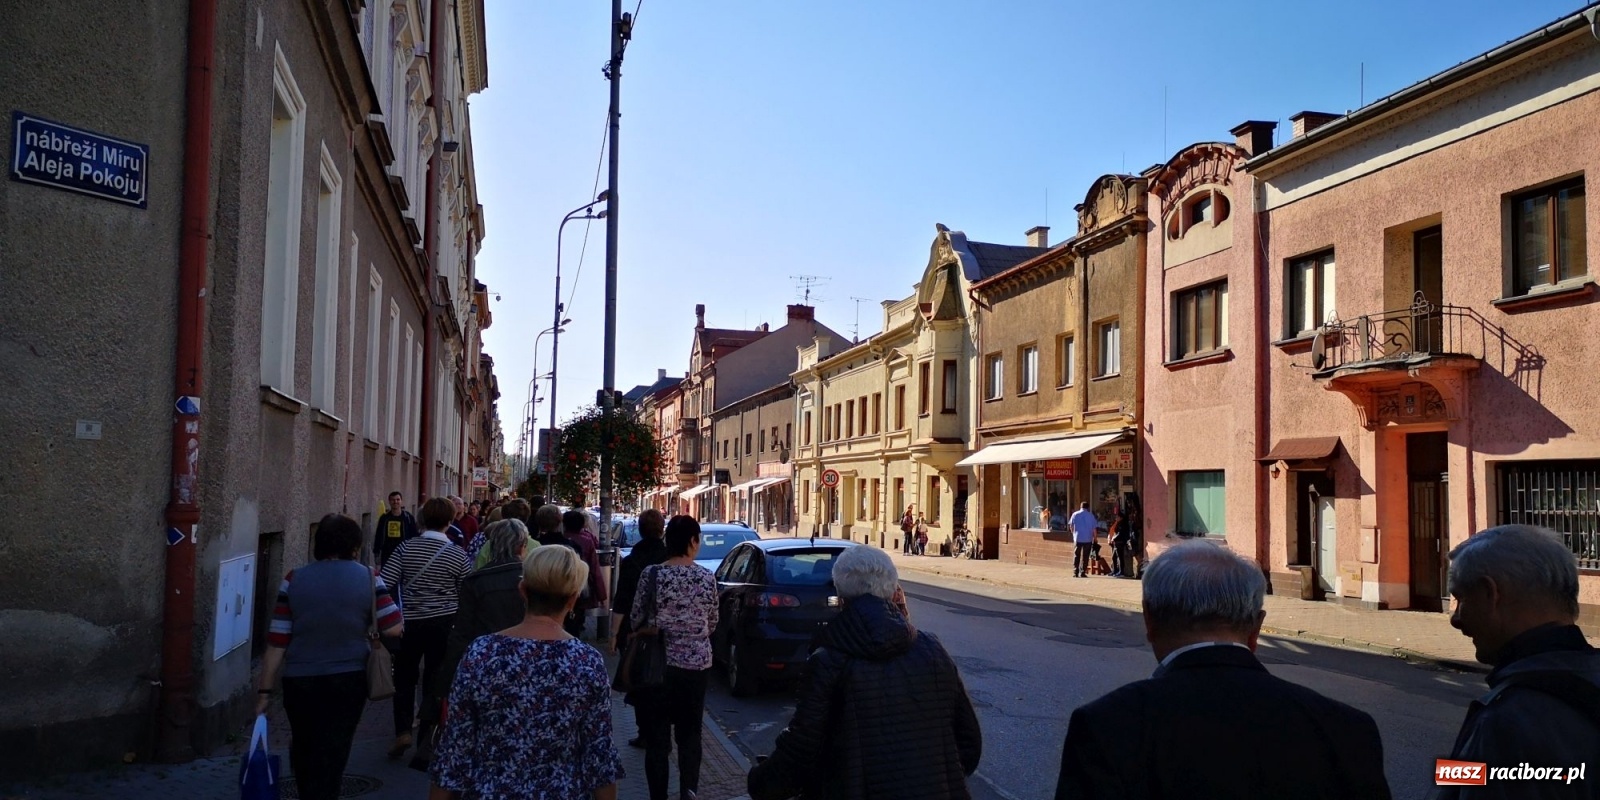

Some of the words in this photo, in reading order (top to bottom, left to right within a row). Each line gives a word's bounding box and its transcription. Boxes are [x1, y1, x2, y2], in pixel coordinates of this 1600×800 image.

[26, 130, 97, 160] nábřeží
[102, 145, 140, 172] Míru
[24, 151, 74, 180] Aleja
[80, 162, 140, 195] Pokoju
[825, 474, 835, 483] 30
